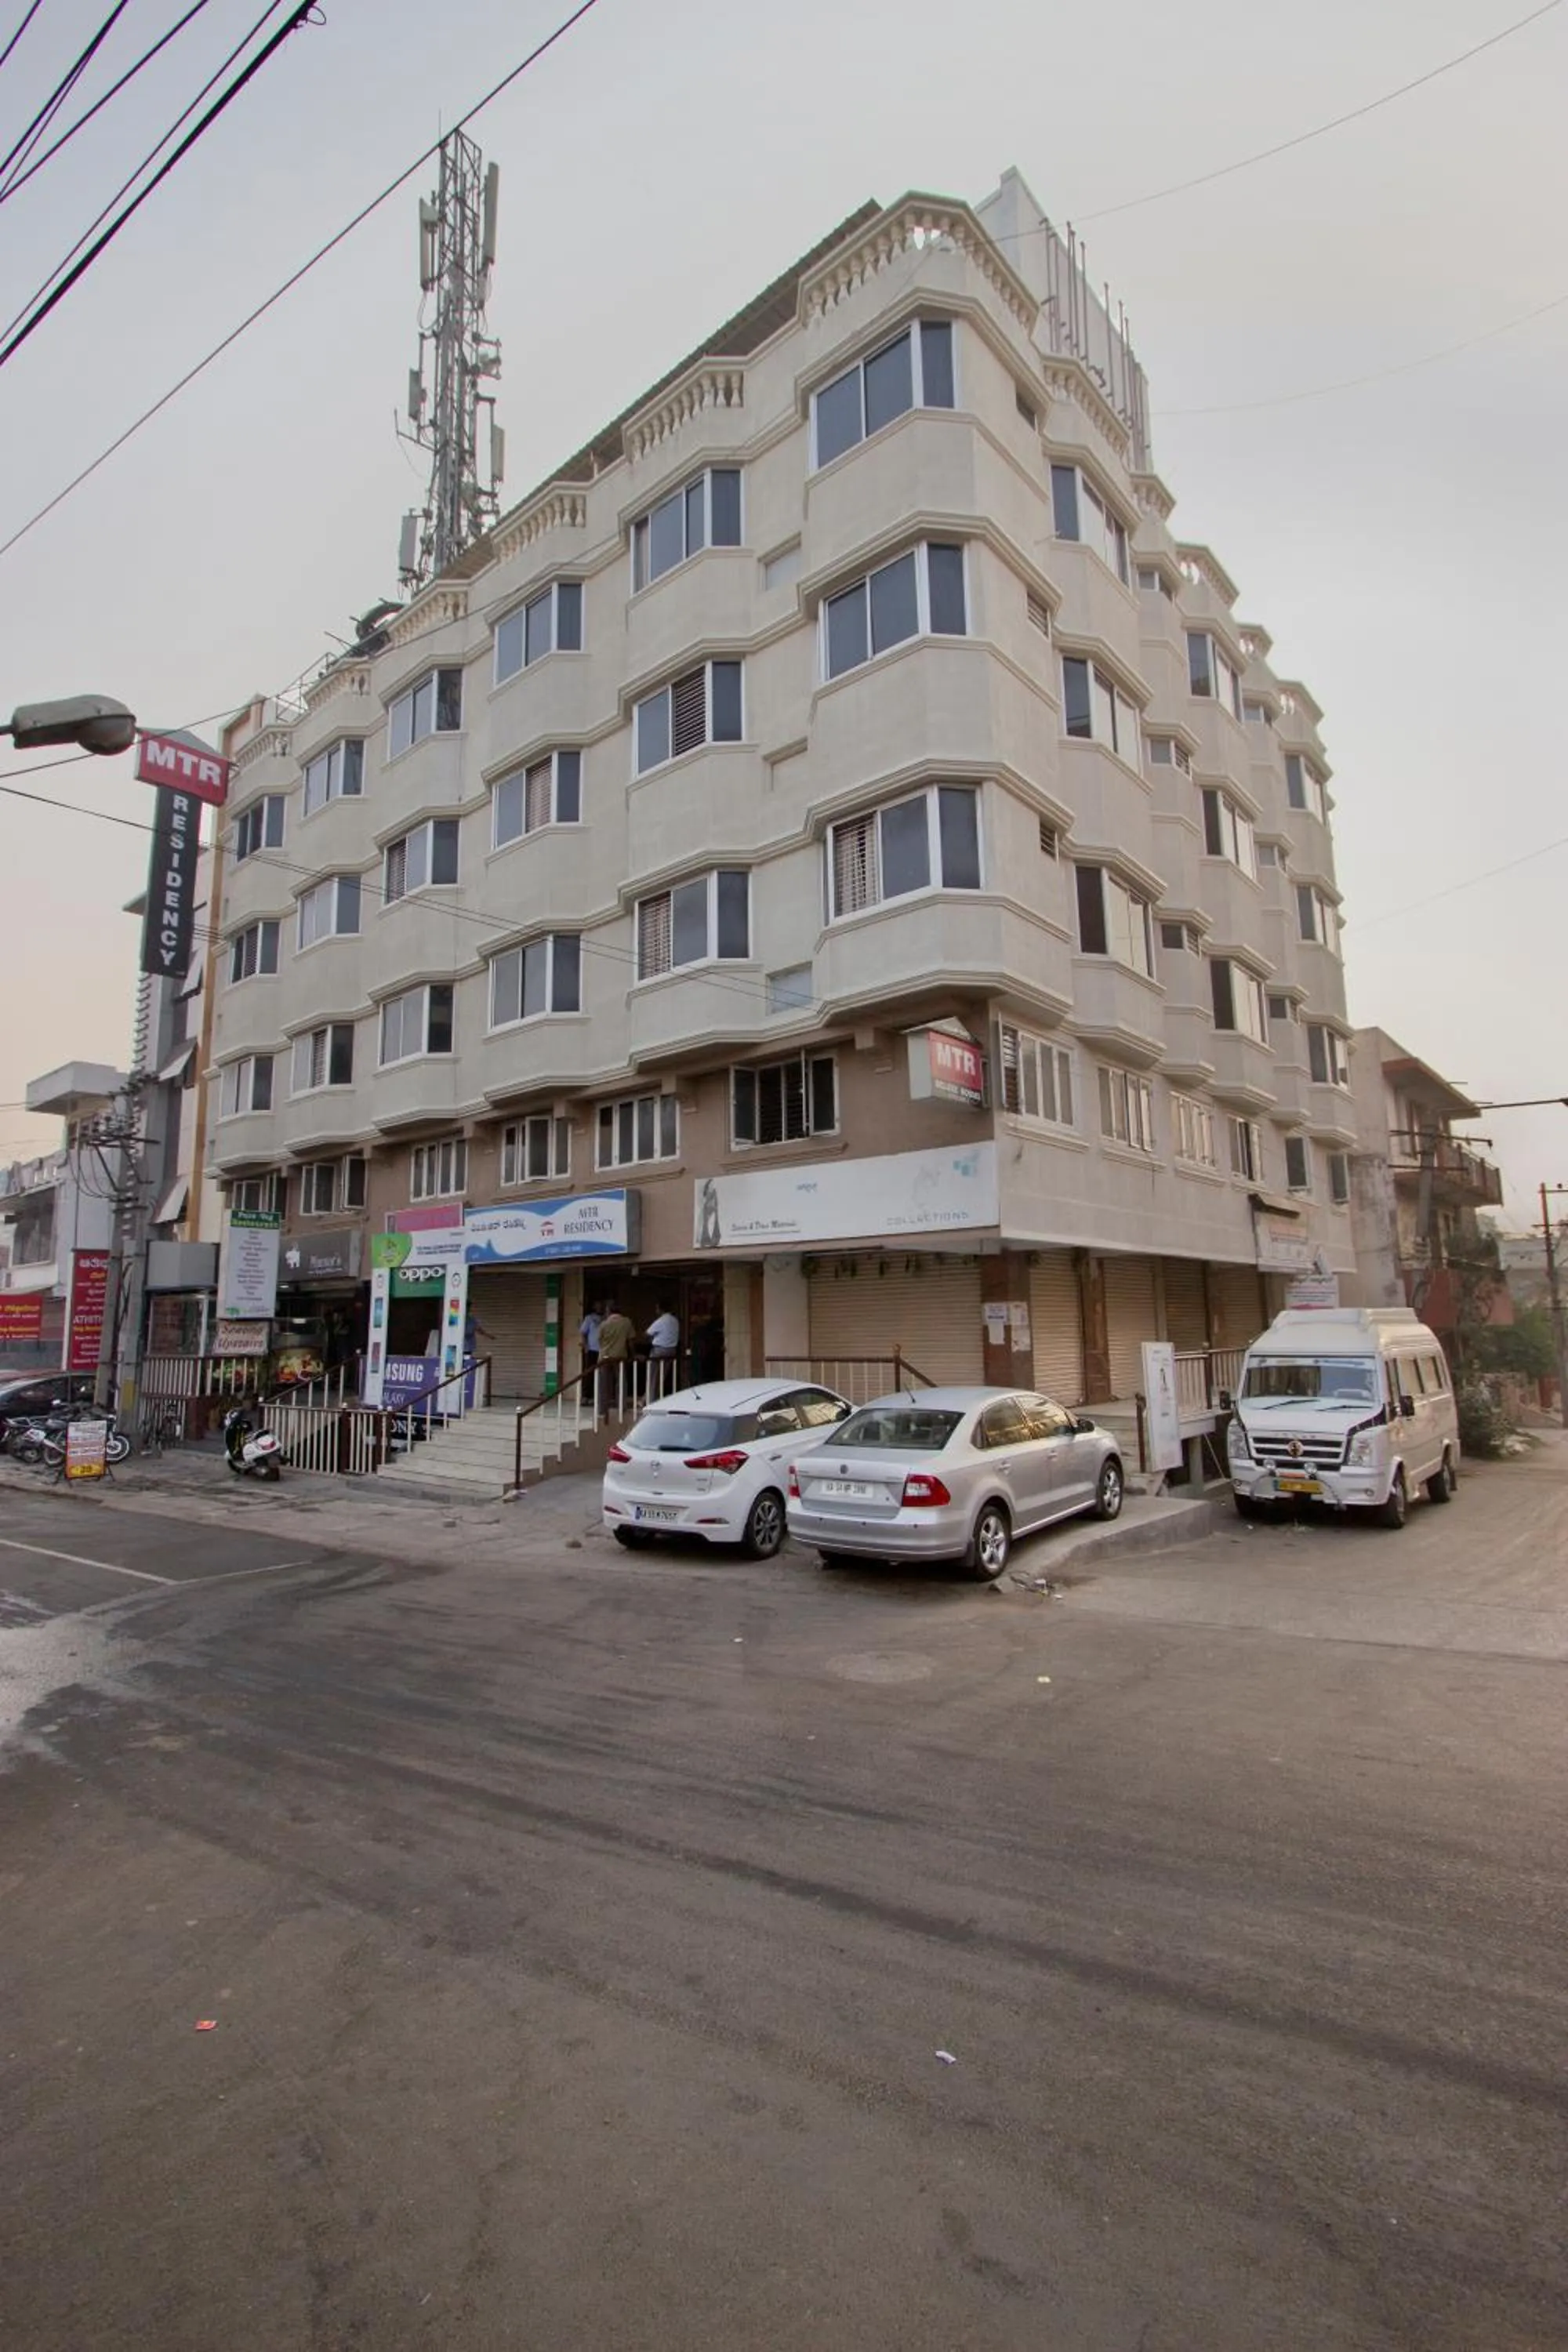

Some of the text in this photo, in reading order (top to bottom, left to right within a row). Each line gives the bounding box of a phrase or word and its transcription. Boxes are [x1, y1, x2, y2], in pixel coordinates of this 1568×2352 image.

[147, 740, 222, 786] MTR
[160, 793, 189, 966] RESIDENCY
[936, 1041, 977, 1076] MTR
[564, 1219, 615, 1235] RESIDENCY
[577, 1206, 599, 1219] MTR
